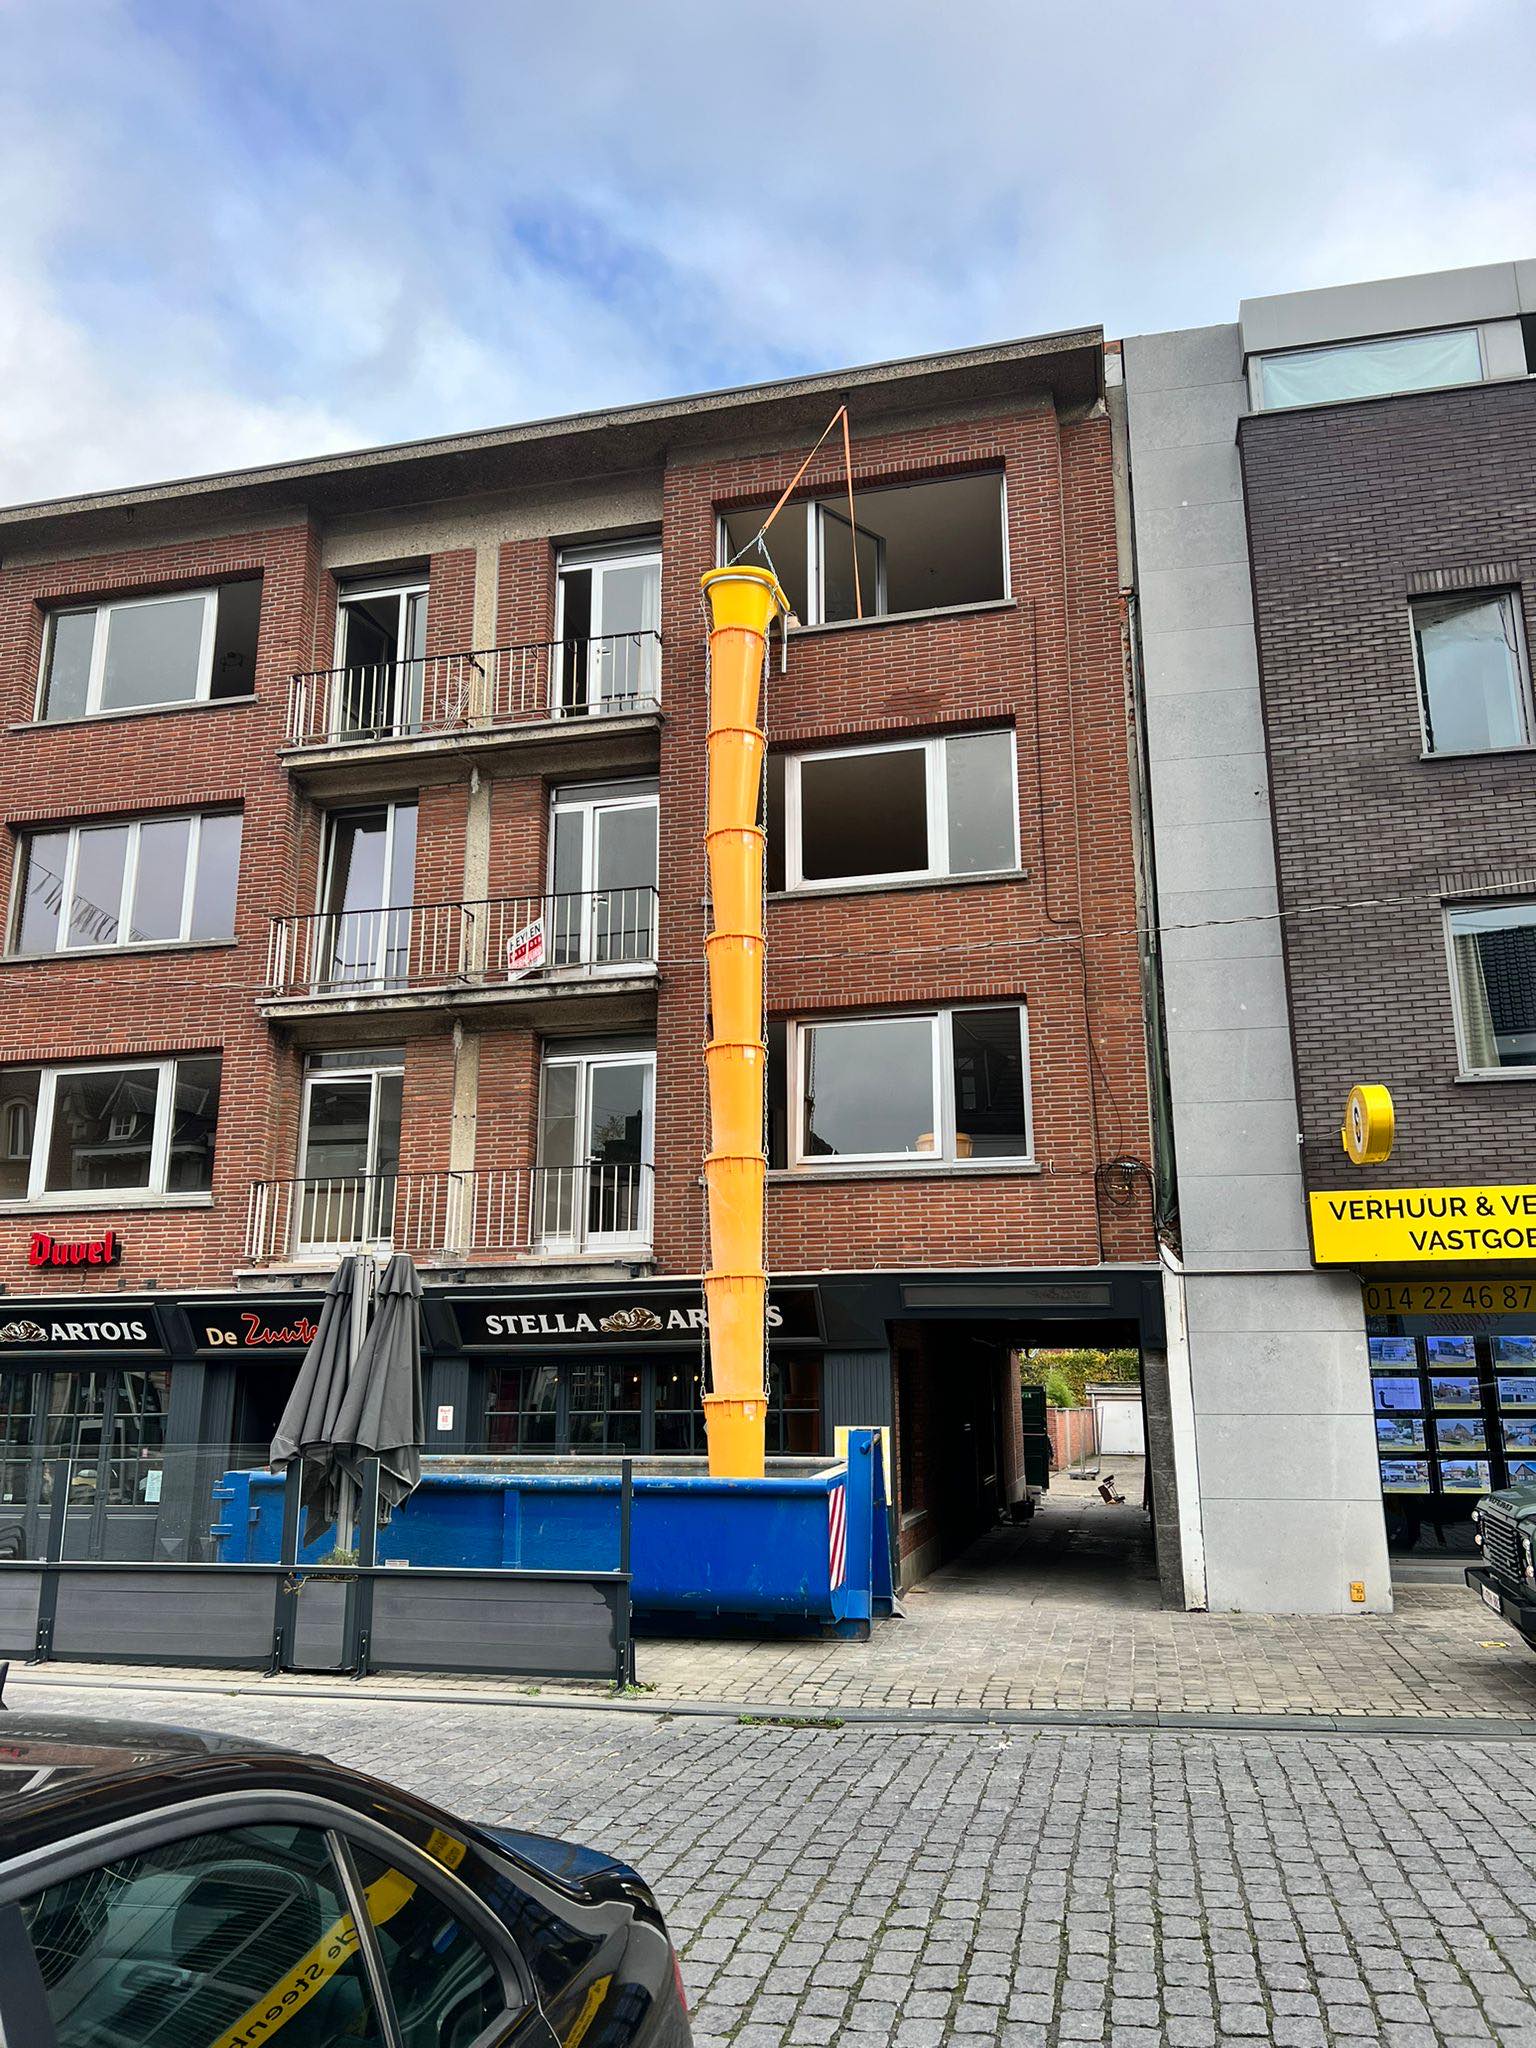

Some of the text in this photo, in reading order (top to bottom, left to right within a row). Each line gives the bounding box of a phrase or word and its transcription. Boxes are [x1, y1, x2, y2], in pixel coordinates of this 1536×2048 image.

[1328, 1194, 1536, 1220] VERHUUR & VE
[28, 1231, 113, 1265] Duvel
[1367, 1285, 1533, 1311] 014 22 46 87
[51, 1321, 147, 1341] ARTOIS
[485, 1305, 783, 1335] STELLA ARS
[205, 1327, 238, 1346] De
